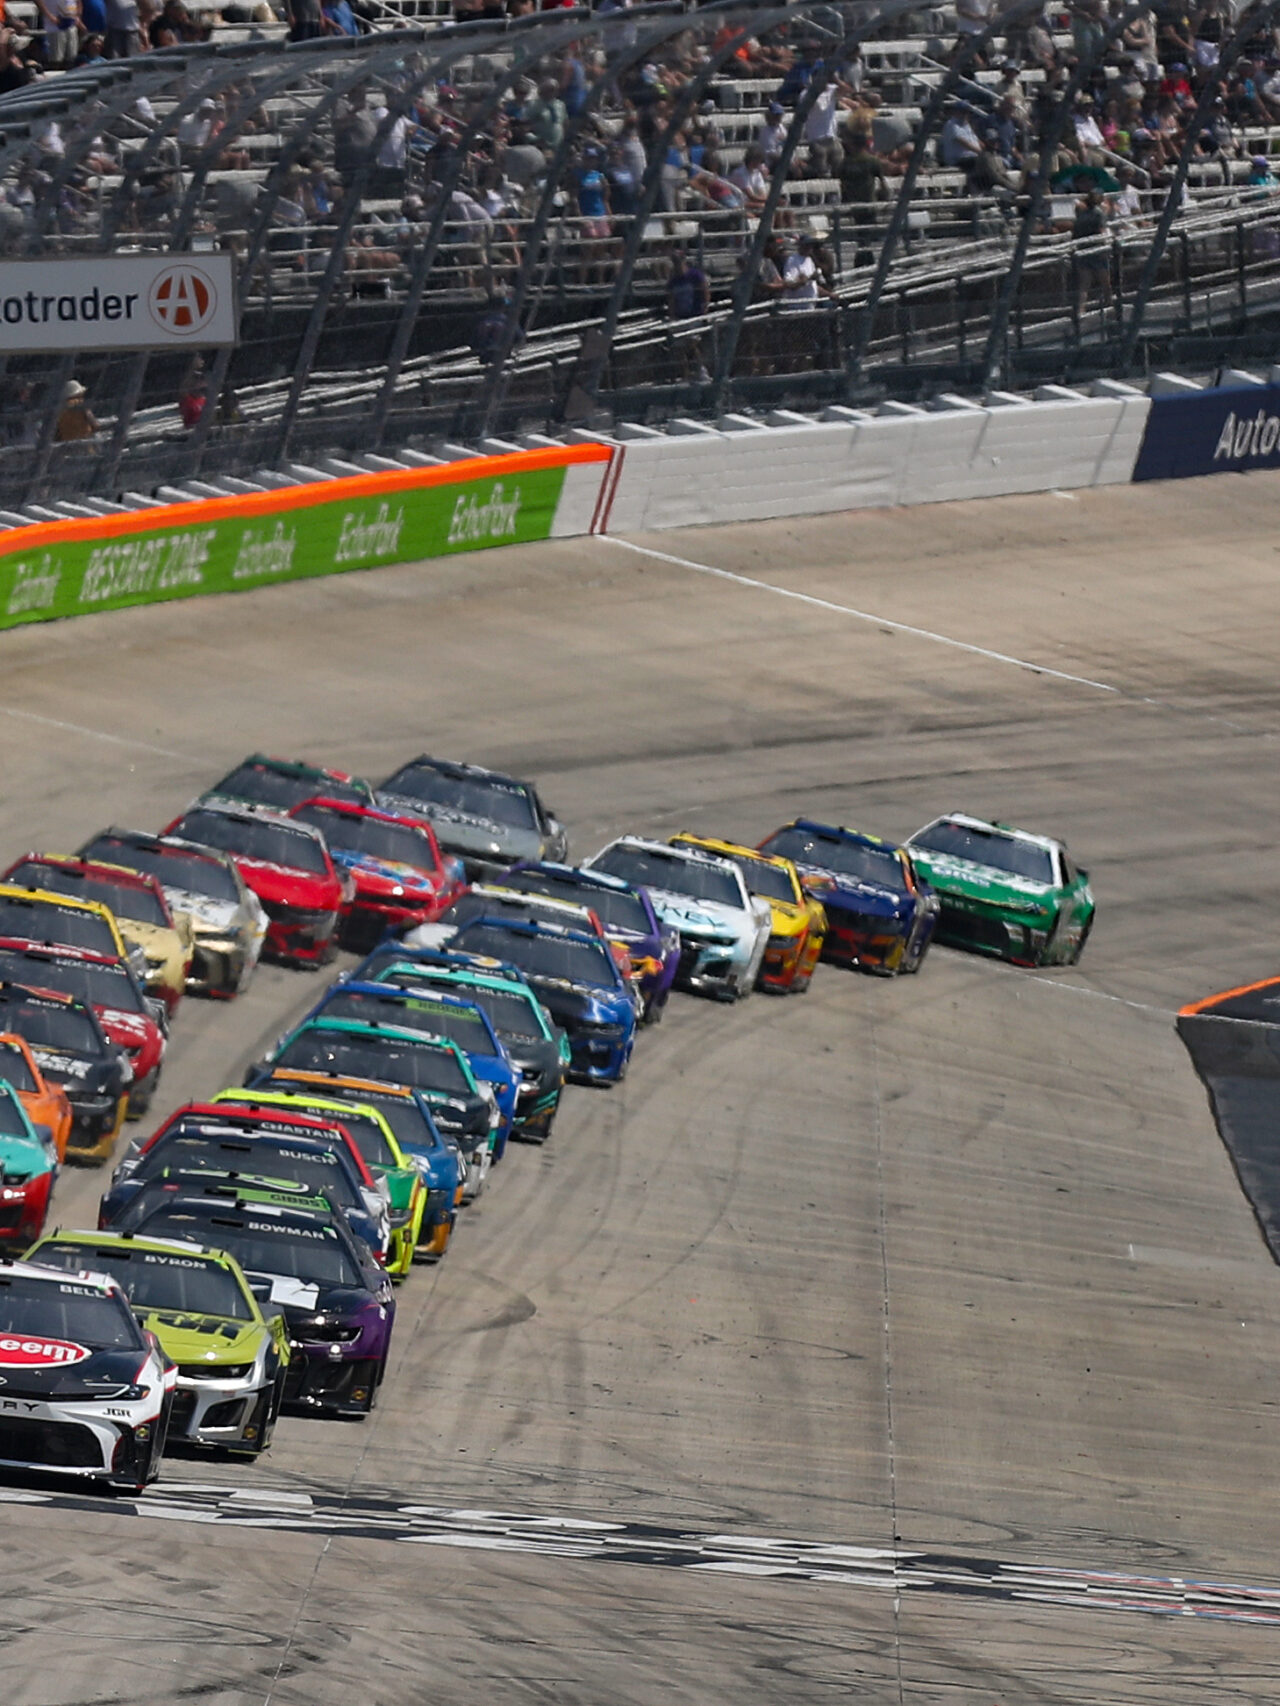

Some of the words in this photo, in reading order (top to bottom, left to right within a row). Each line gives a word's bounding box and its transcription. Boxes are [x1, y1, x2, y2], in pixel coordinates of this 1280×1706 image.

[1214, 408, 1280, 461] Auto
[270, 1193, 320, 1207] GIBBS
[248, 1221, 324, 1240] BOWMAN
[144, 1254, 207, 1269] BYRON
[60, 1284, 106, 1299] BELL
[102, 1407, 132, 1418] JGR
